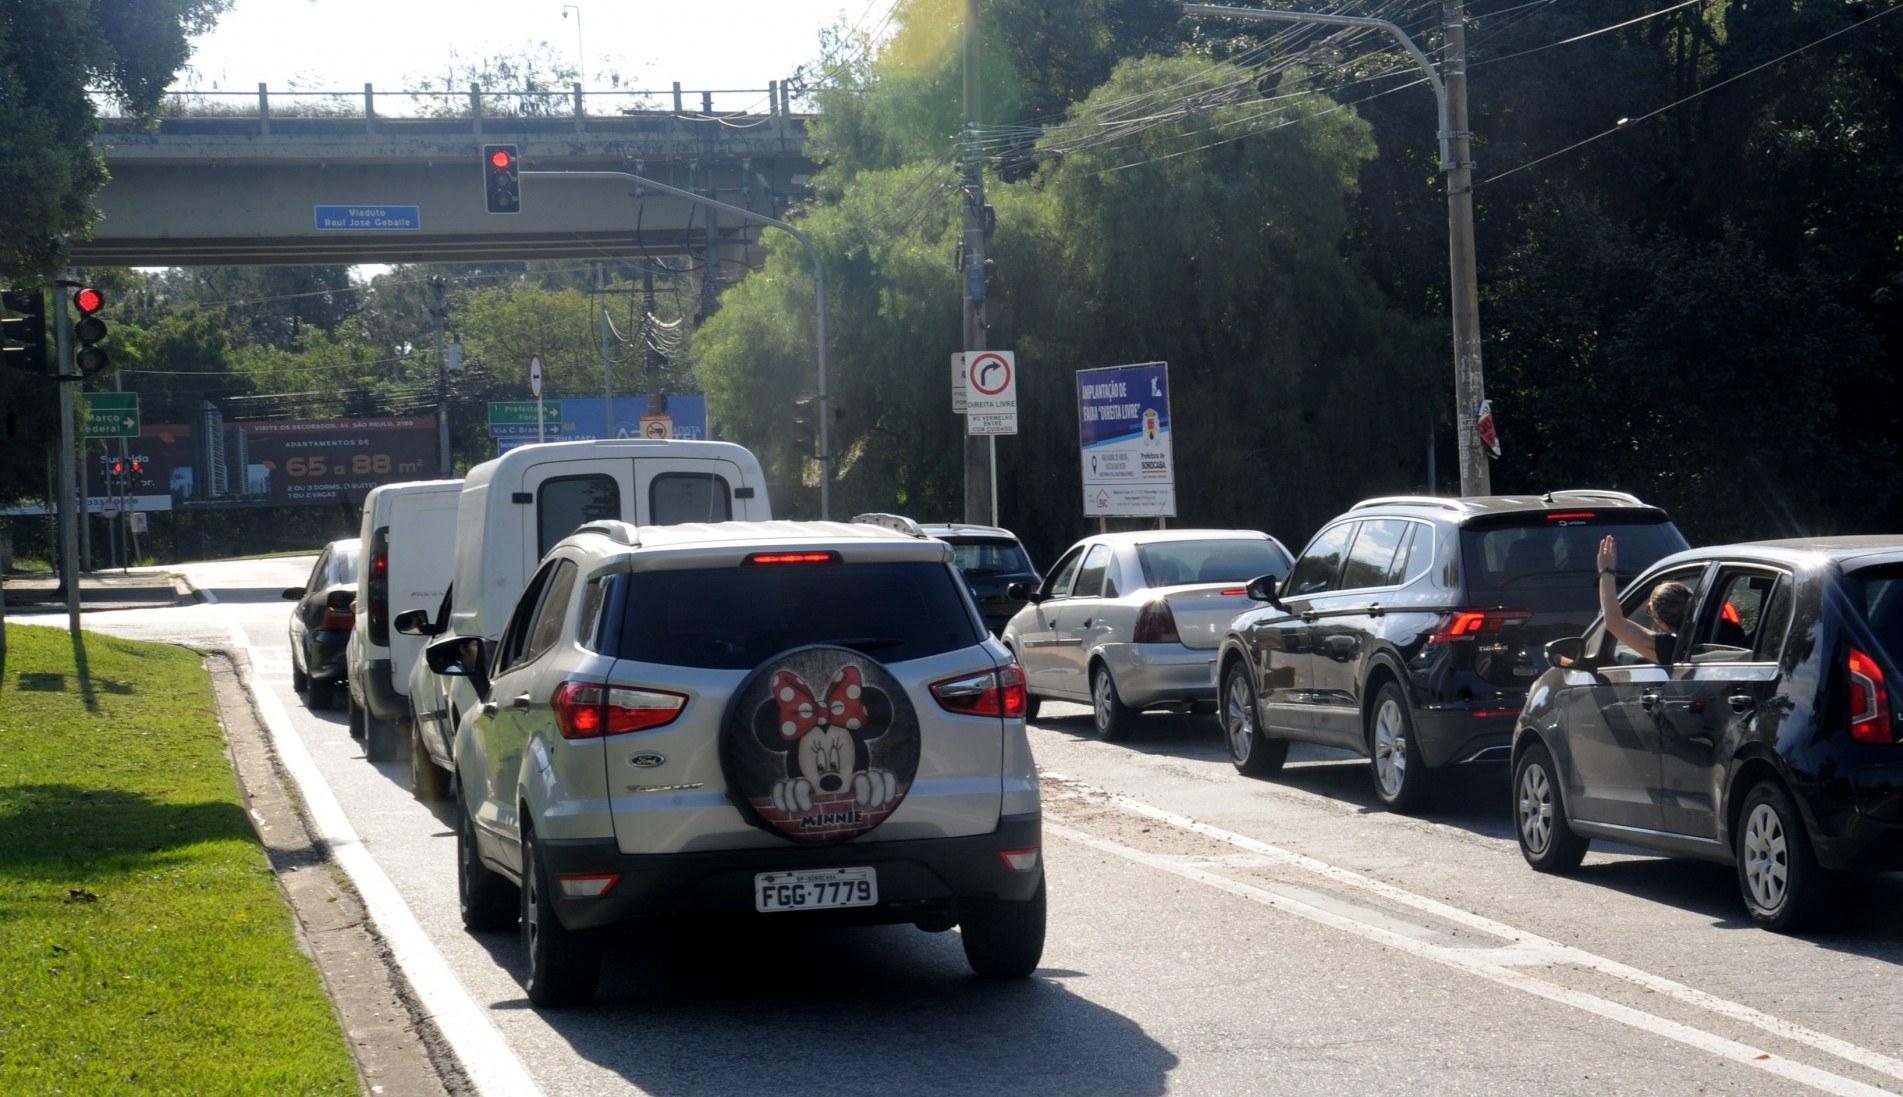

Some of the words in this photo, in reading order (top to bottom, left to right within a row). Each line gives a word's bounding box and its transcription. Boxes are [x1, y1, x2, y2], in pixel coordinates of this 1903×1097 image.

[348, 208, 386, 216] Viaduto
[324, 218, 346, 226] Raul
[1082, 380, 1118, 402] IMPLANTAÇÃO
[1119, 382, 1127, 398] DE
[1084, 406, 1098, 421] FAIXA
[82, 425, 121, 433] ederal
[286, 456, 327, 476] 65
[334, 465, 345, 475] a
[352, 454, 391, 474] 88
[1142, 461, 1166, 469] SOROCABA
[802, 811, 862, 827] MINNIE
